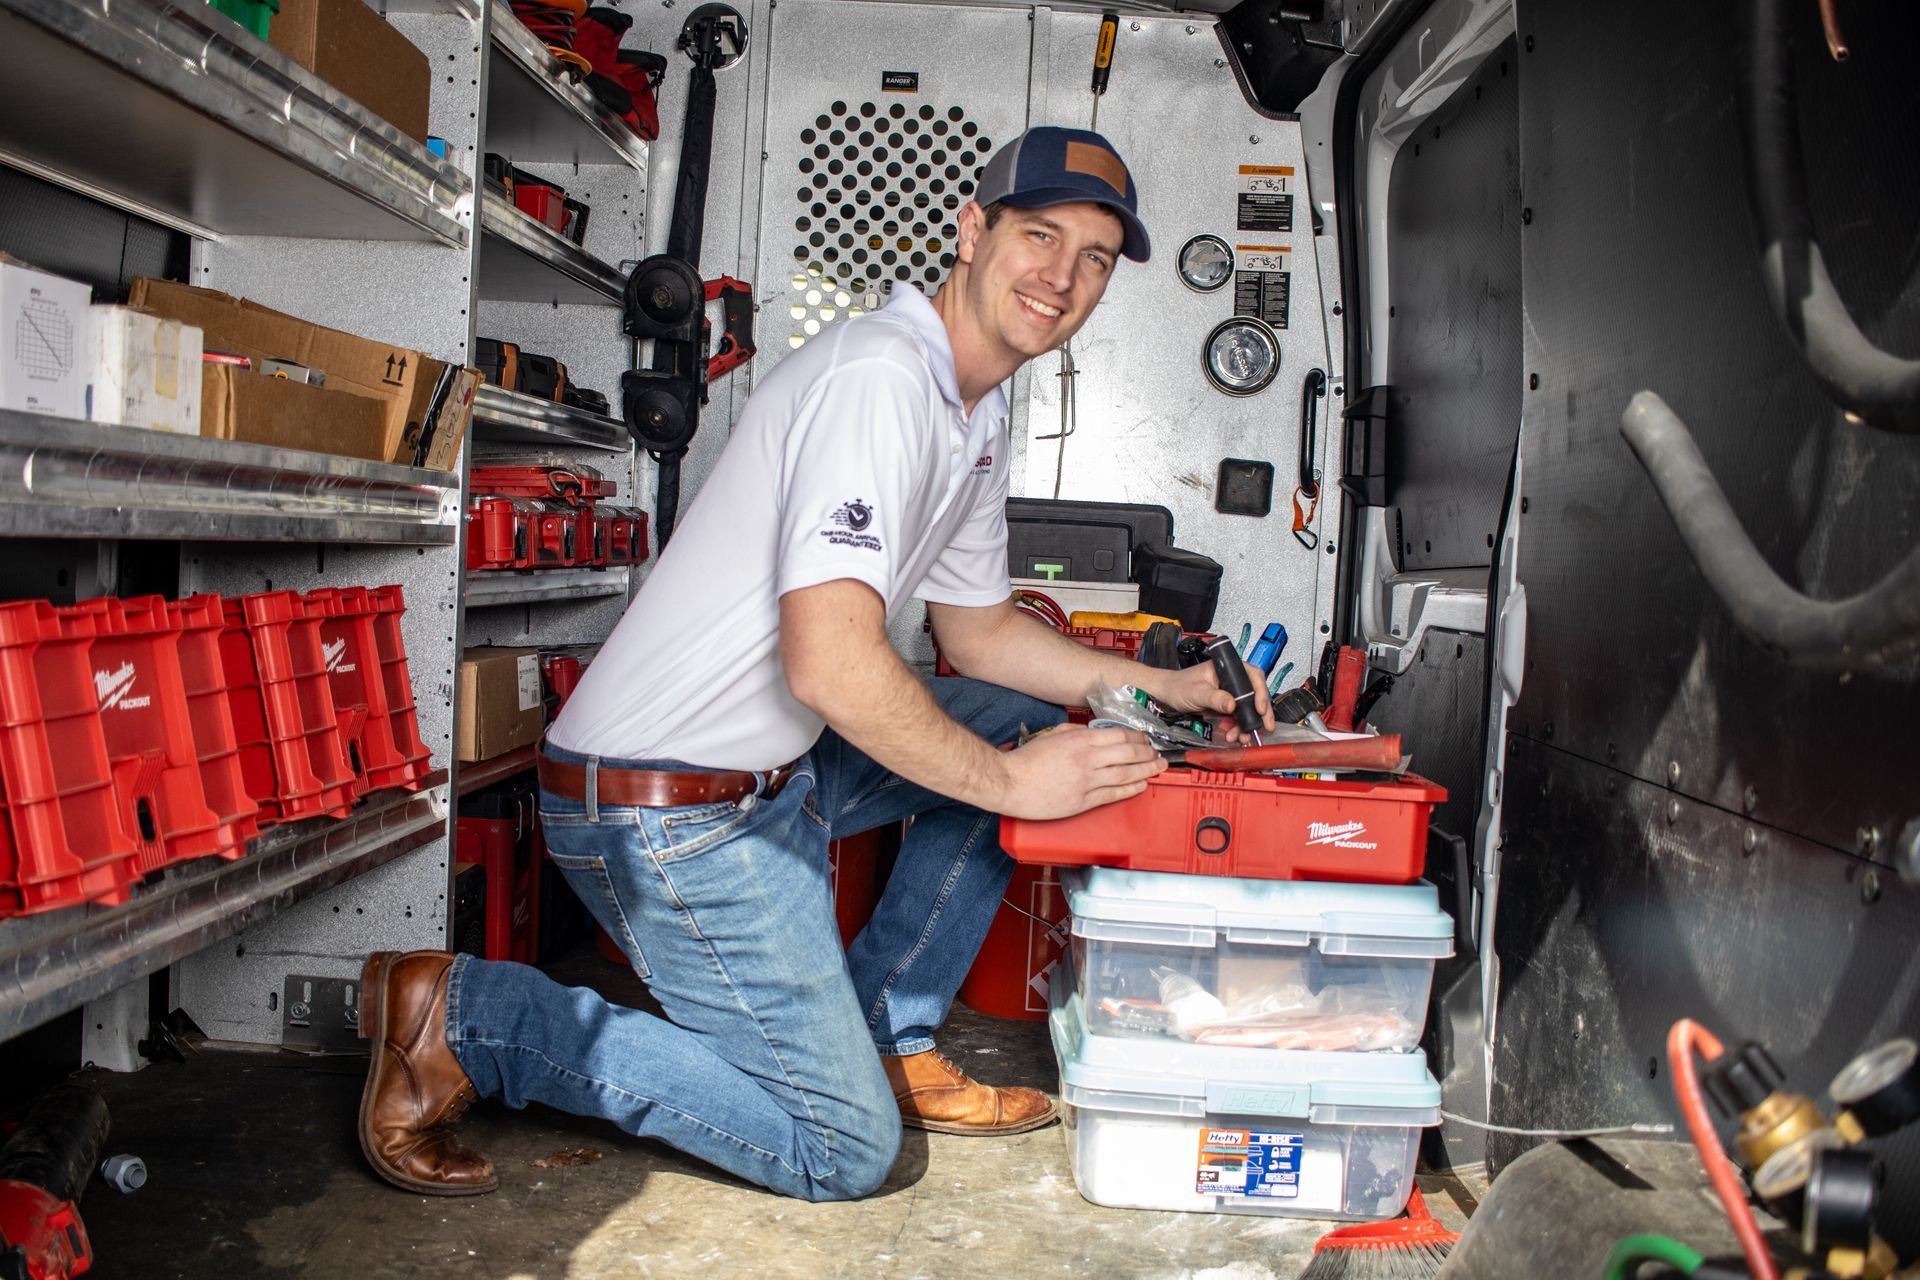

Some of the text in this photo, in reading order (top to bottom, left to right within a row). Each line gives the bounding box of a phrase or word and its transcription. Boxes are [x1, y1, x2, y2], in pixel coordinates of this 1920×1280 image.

[336, 663, 356, 674] PACKOUT
[94, 660, 136, 702] Milwaukee
[119, 695, 151, 711] PACKOUT
[1306, 819, 1364, 840] Milwaukee
[1334, 840, 1378, 850] PACKOUT
[1228, 1090, 1290, 1114] Hefty
[1209, 1133, 1241, 1144] Hefty
